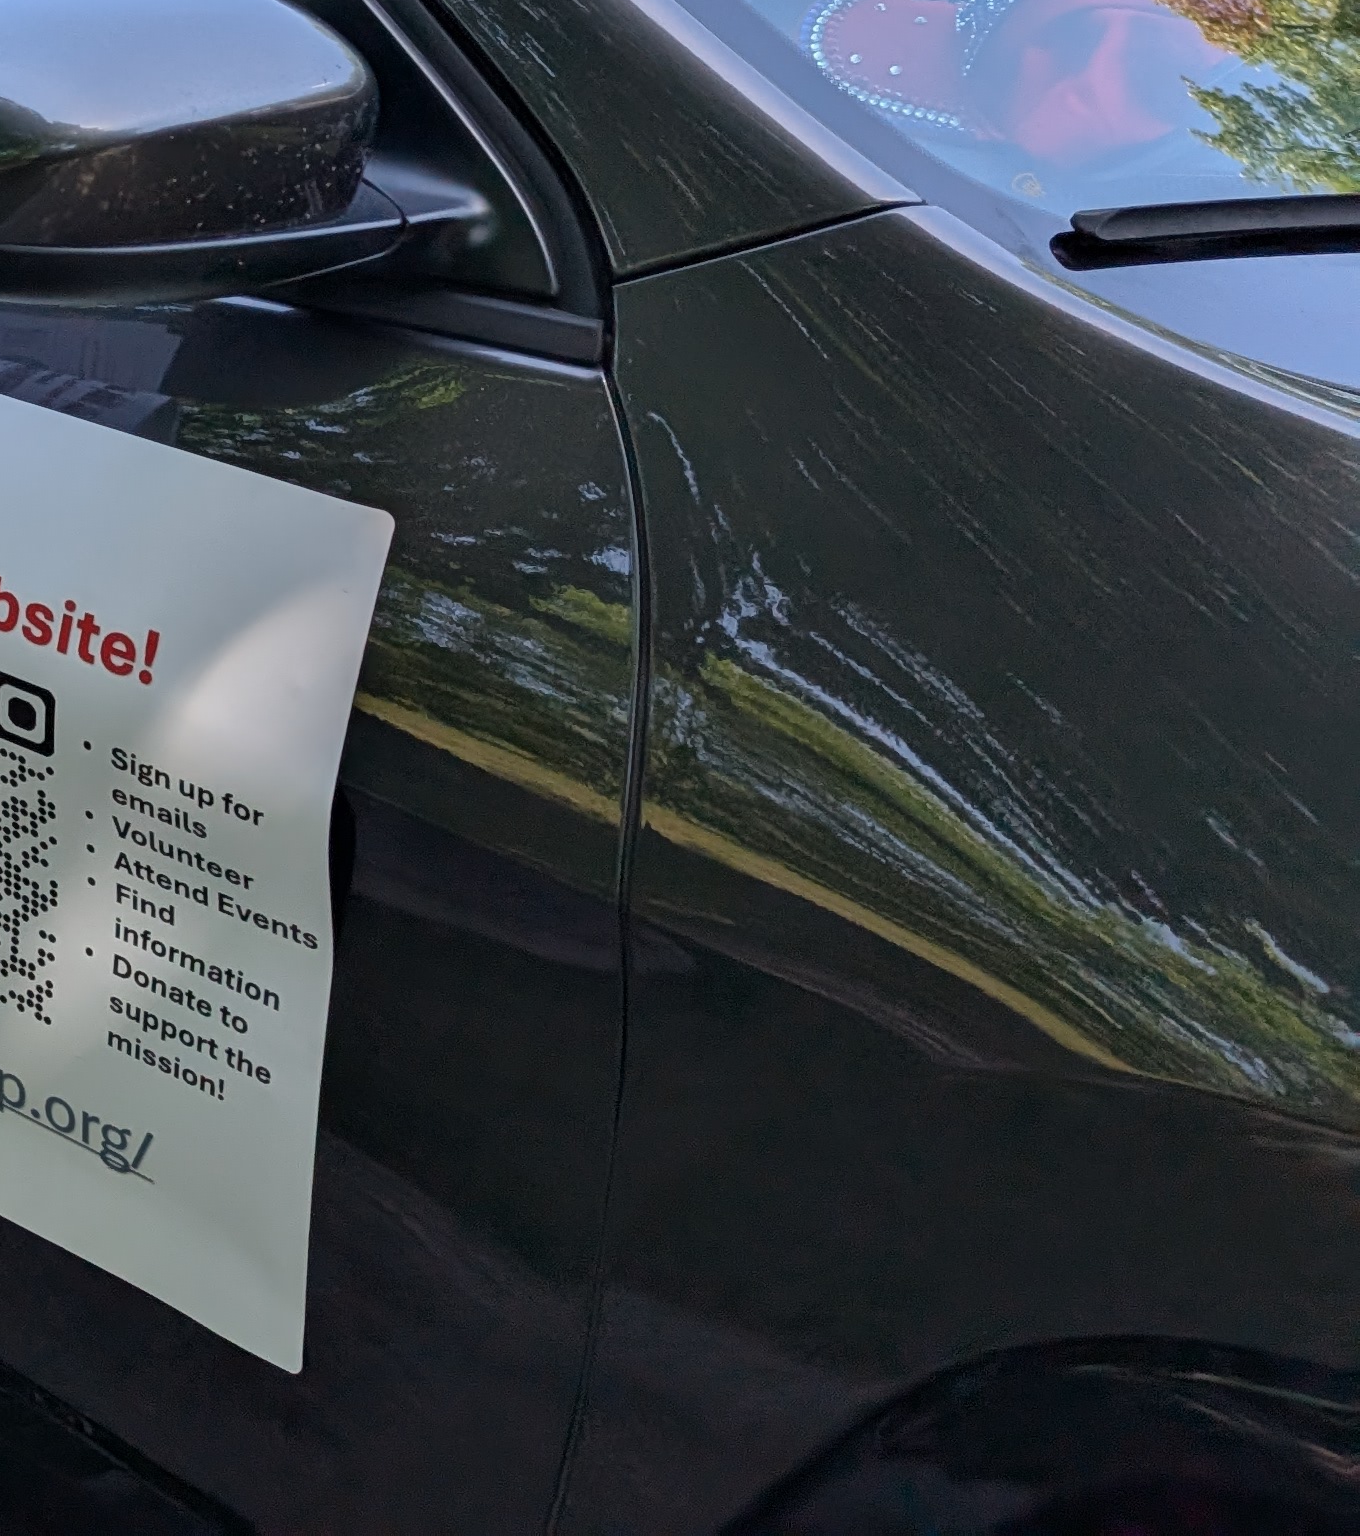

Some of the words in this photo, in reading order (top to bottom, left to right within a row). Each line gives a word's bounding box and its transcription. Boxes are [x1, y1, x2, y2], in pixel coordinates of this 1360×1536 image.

[111, 747, 170, 790] Sign
[179, 777, 214, 809] up
[222, 793, 265, 826] for
[111, 787, 208, 840] emails
[111, 815, 255, 891] Volunteer
[113, 852, 209, 907] Attend
[217, 892, 319, 950] Events
[115, 883, 176, 927] Find
[112, 953, 213, 1018] Donate
[219, 1005, 249, 1035] to
[114, 917, 281, 1012] information
[106, 1029, 226, 1102] mission!
[109, 994, 219, 1061] support
[224, 1046, 272, 1085] the
